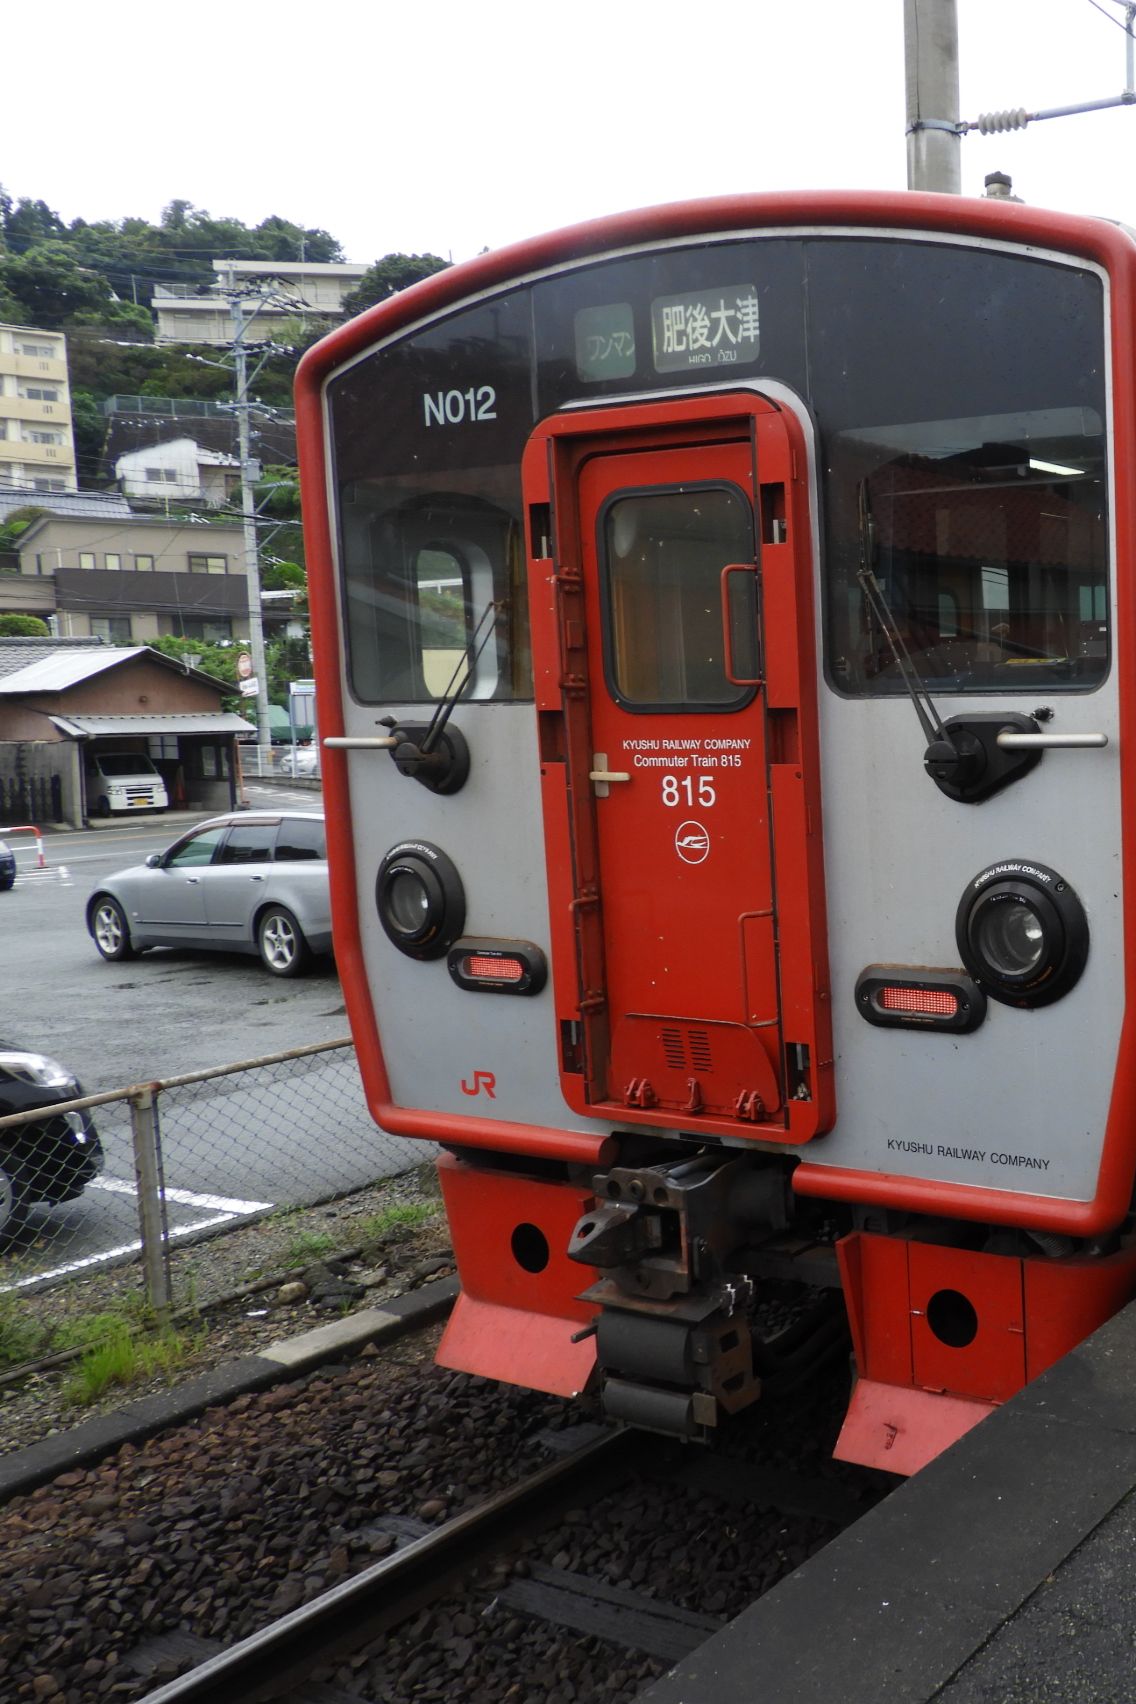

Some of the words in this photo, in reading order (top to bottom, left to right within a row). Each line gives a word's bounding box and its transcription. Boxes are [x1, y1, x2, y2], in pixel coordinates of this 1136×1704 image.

[663, 294, 760, 353] 肥後大津
[622, 740, 660, 750] KYUSHU
[662, 739, 701, 750] RAILWAY
[704, 739, 751, 749] COMPANY
[634, 754, 689, 767] Commuter
[690, 754, 718, 767] Train
[720, 755, 742, 767] 815
[661, 775, 716, 807] 815
[995, 863, 1021, 874] RAILWAY
[1021, 865, 1052, 883] COMPANY
[461, 1071, 497, 1099] JR
[887, 1138, 933, 1156] KYUSHU
[937, 1145, 987, 1162] RAILWAY
[990, 1152, 1050, 1171] COMPANY
